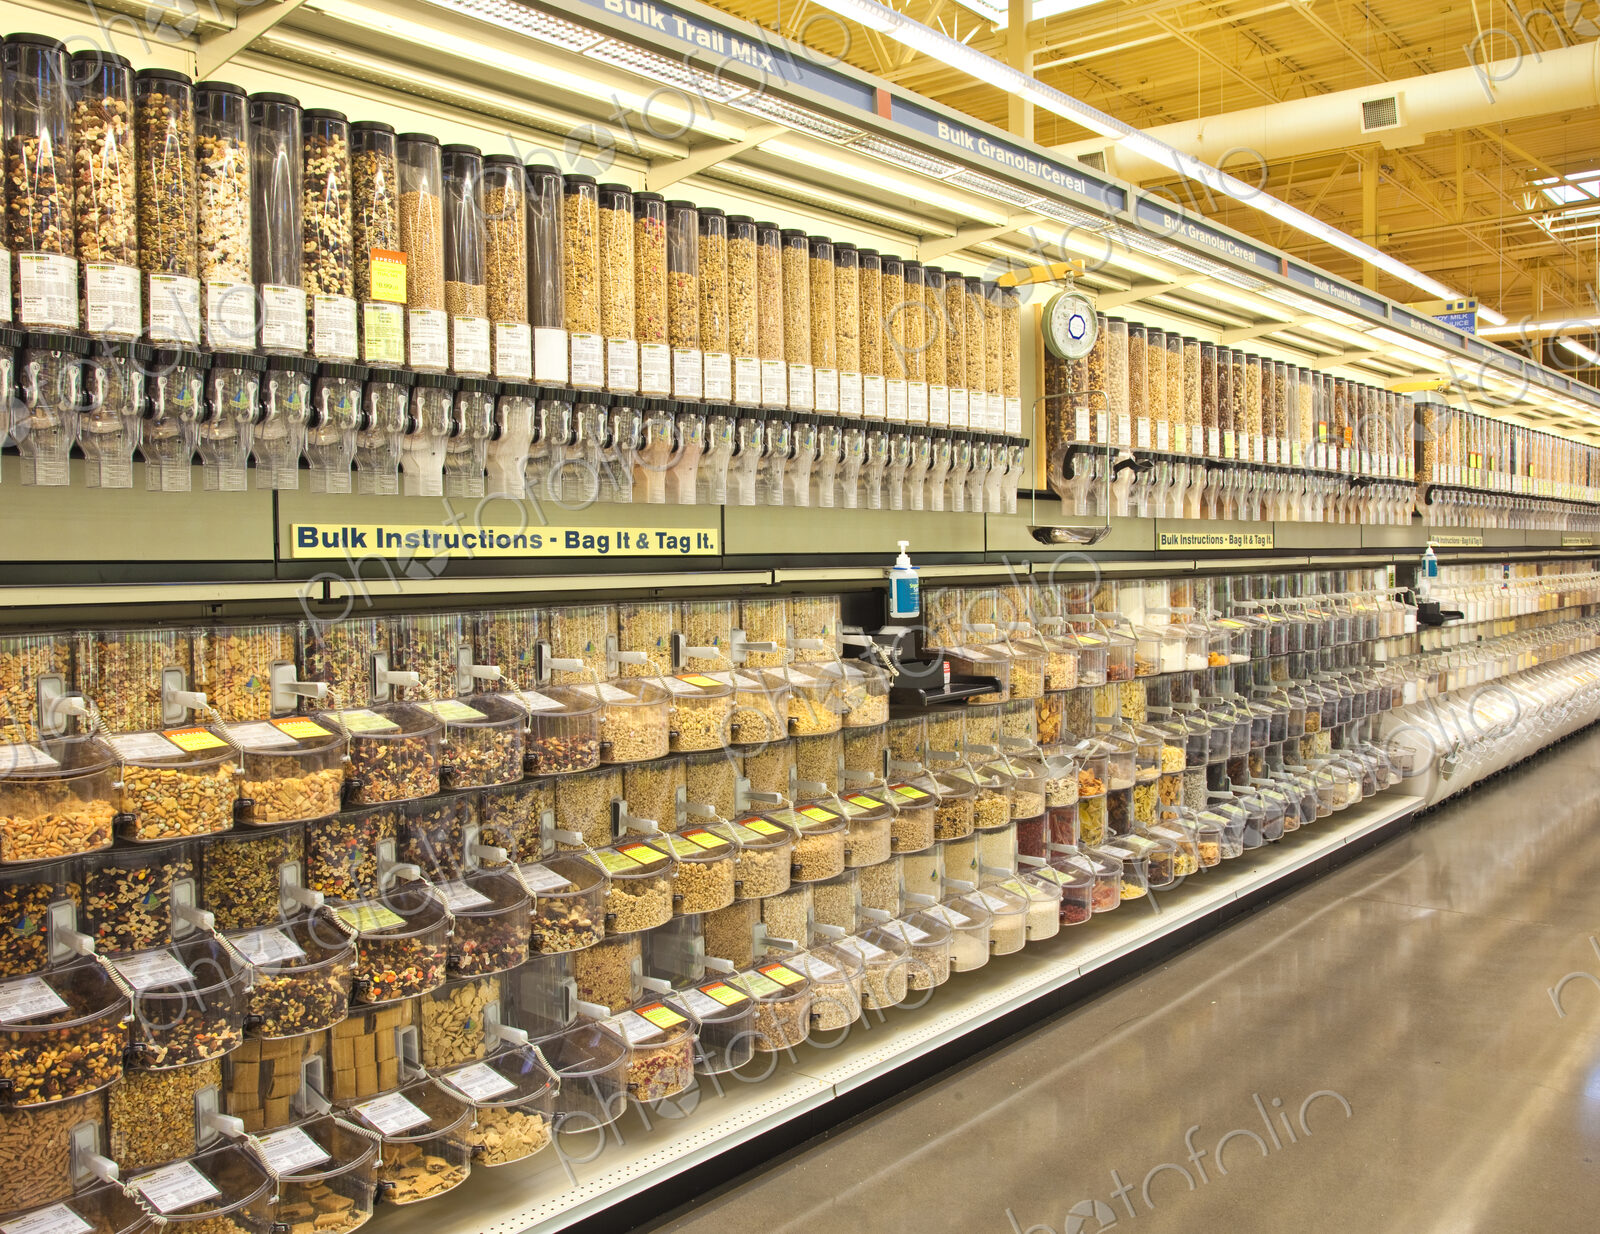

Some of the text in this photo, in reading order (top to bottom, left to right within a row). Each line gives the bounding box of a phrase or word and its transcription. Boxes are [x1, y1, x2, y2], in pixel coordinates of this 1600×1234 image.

[604, 0, 773, 73] Bulk Trail Mix
[937, 121, 1086, 194] Bulk Granola/Cereal
[1163, 214, 1257, 264] Bulk Granola/Cereal
[1314, 276, 1330, 294] Bulk
[297, 526, 367, 548] Bulk
[376, 527, 543, 549] Instructions
[565, 531, 609, 553] Bag
[617, 531, 630, 549] It
[636, 533, 649, 549] &
[655, 532, 690, 553] Tag
[697, 532, 714, 549] It.
[1161, 534, 1178, 545] Bulk
[1180, 534, 1224, 545] Instructions
[1229, 534, 1242, 546] Bag
[1254, 534, 1265, 546] Tag
